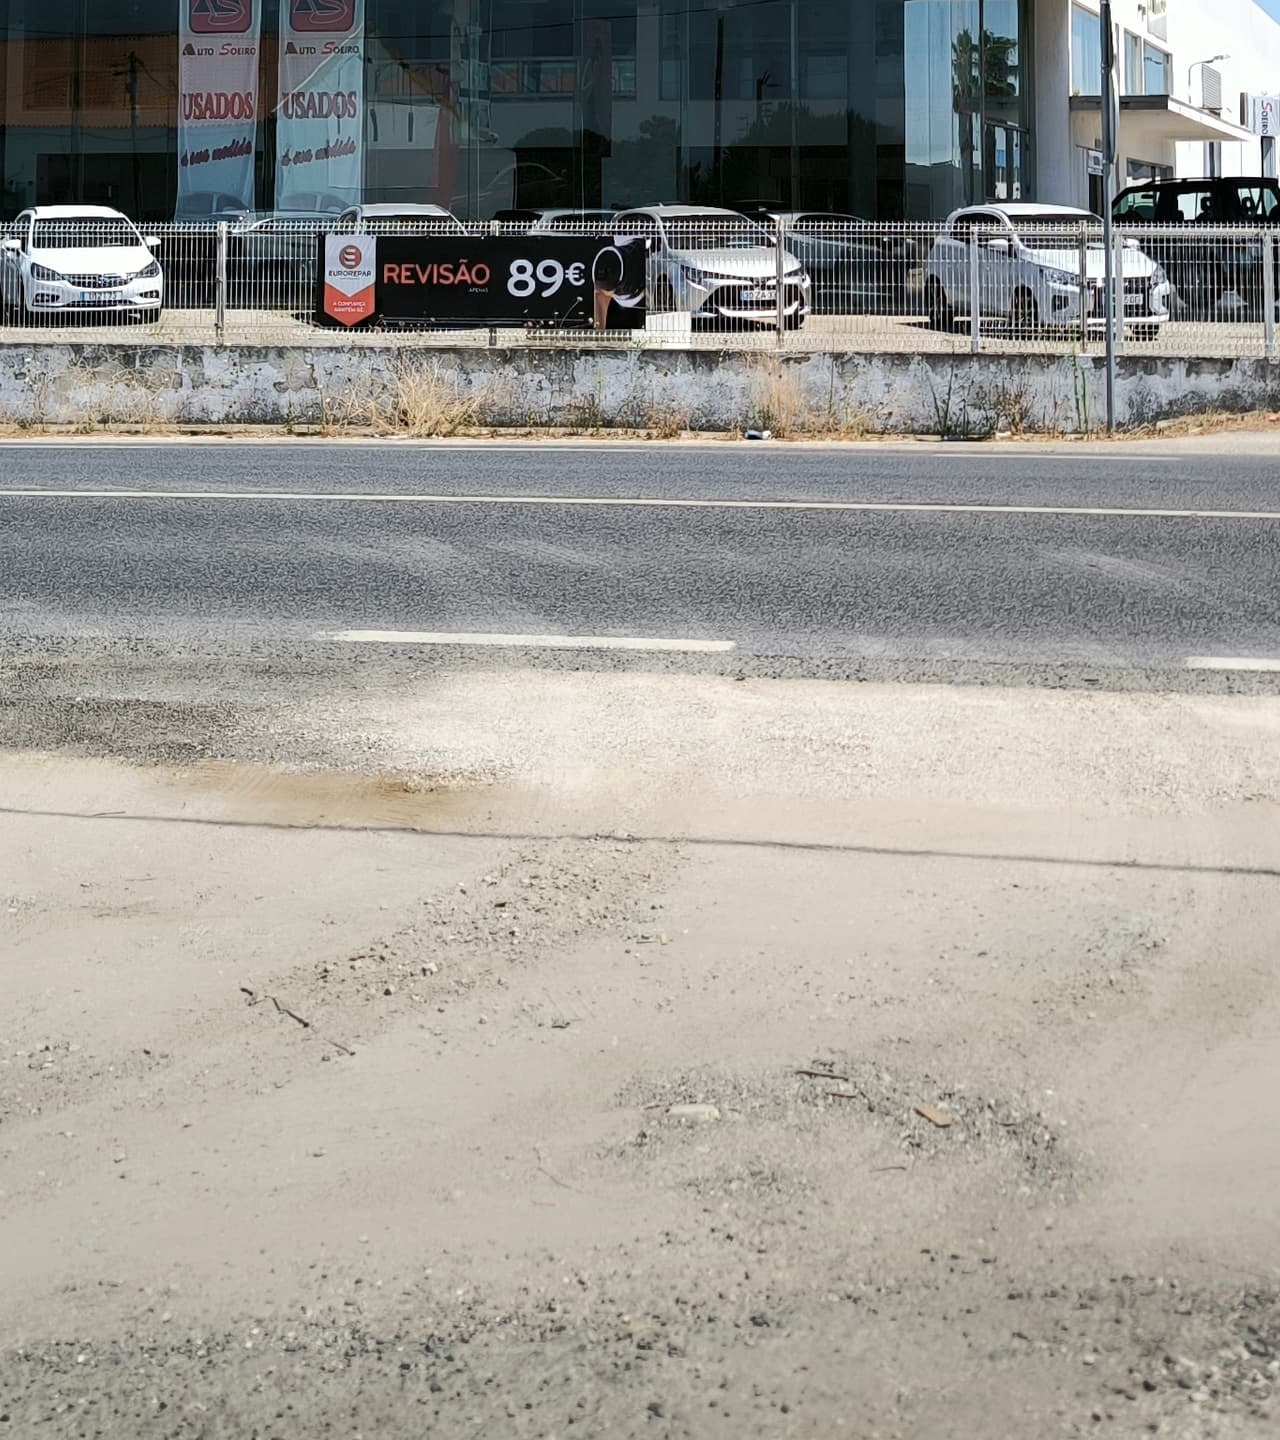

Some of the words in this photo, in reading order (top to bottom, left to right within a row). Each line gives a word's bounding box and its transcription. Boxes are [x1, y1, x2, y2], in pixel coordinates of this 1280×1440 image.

[182, 91, 254, 120] USADOS
[282, 91, 357, 120] USADOS
[383, 258, 490, 285] REVISÃO
[507, 259, 585, 297] 89€
